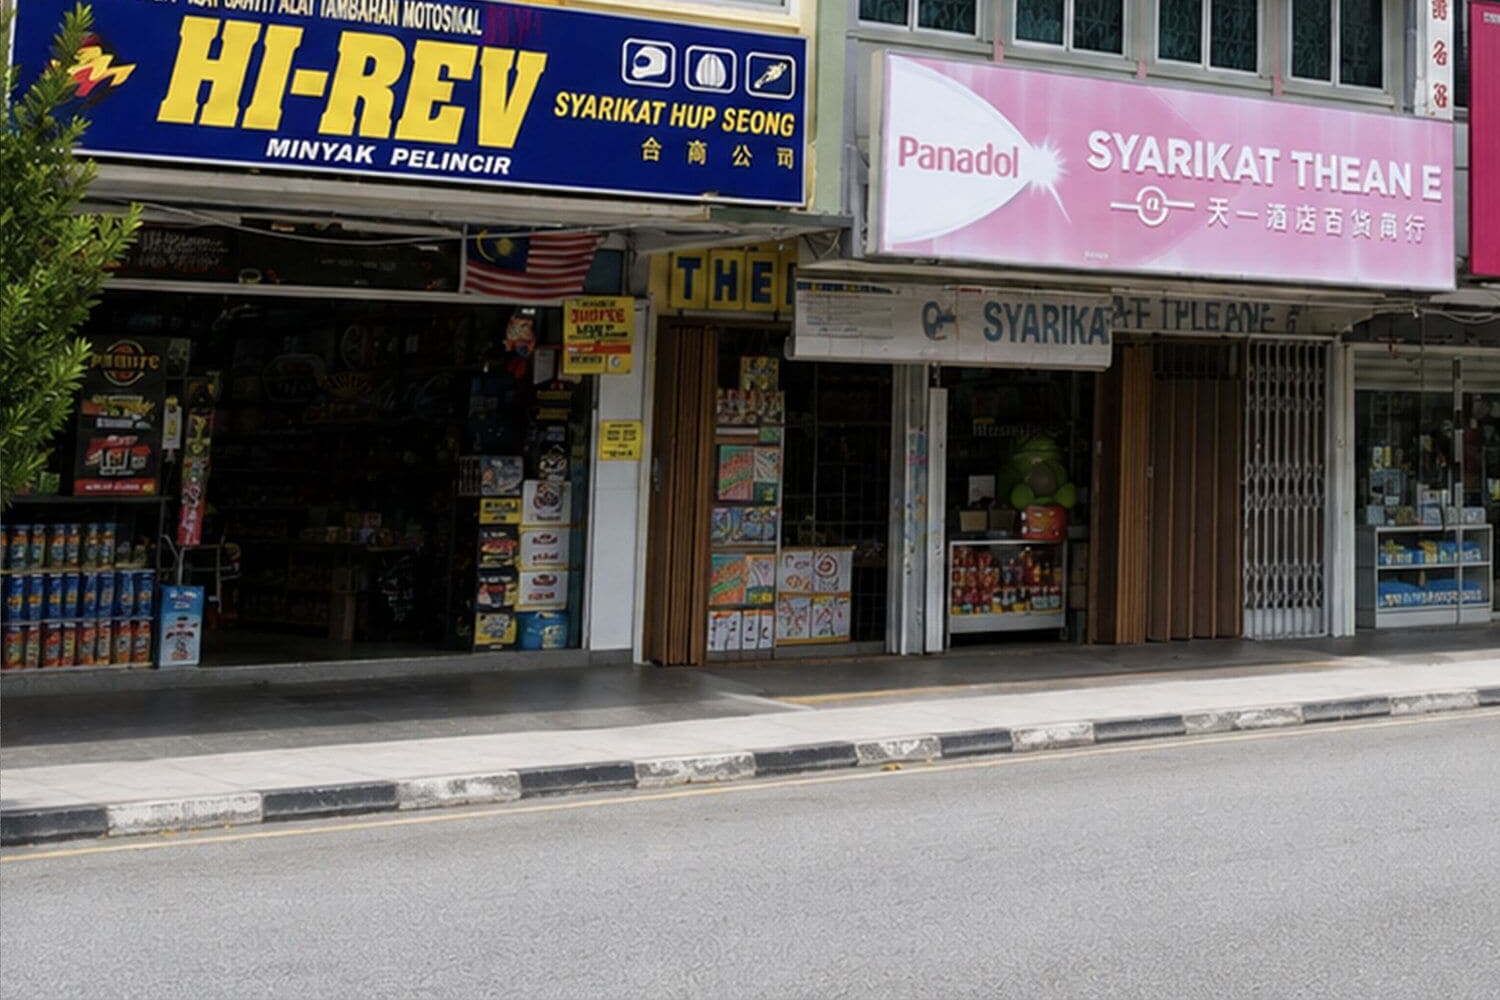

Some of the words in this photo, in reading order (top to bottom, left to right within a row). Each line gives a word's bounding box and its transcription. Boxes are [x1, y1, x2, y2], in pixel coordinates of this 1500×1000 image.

[157, 15, 548, 149] HI-REV
[553, 91, 666, 126] SYARIKAT
[669, 103, 717, 130] HUP
[721, 107, 796, 138] SEONG
[266, 138, 376, 165] MINYAK
[390, 152, 513, 176] PELINCIR
[898, 136, 1019, 179] Panadol
[1087, 129, 1280, 187] SYARIKAT
[1291, 150, 1411, 200] THEAN
[1422, 165, 1443, 202] E
